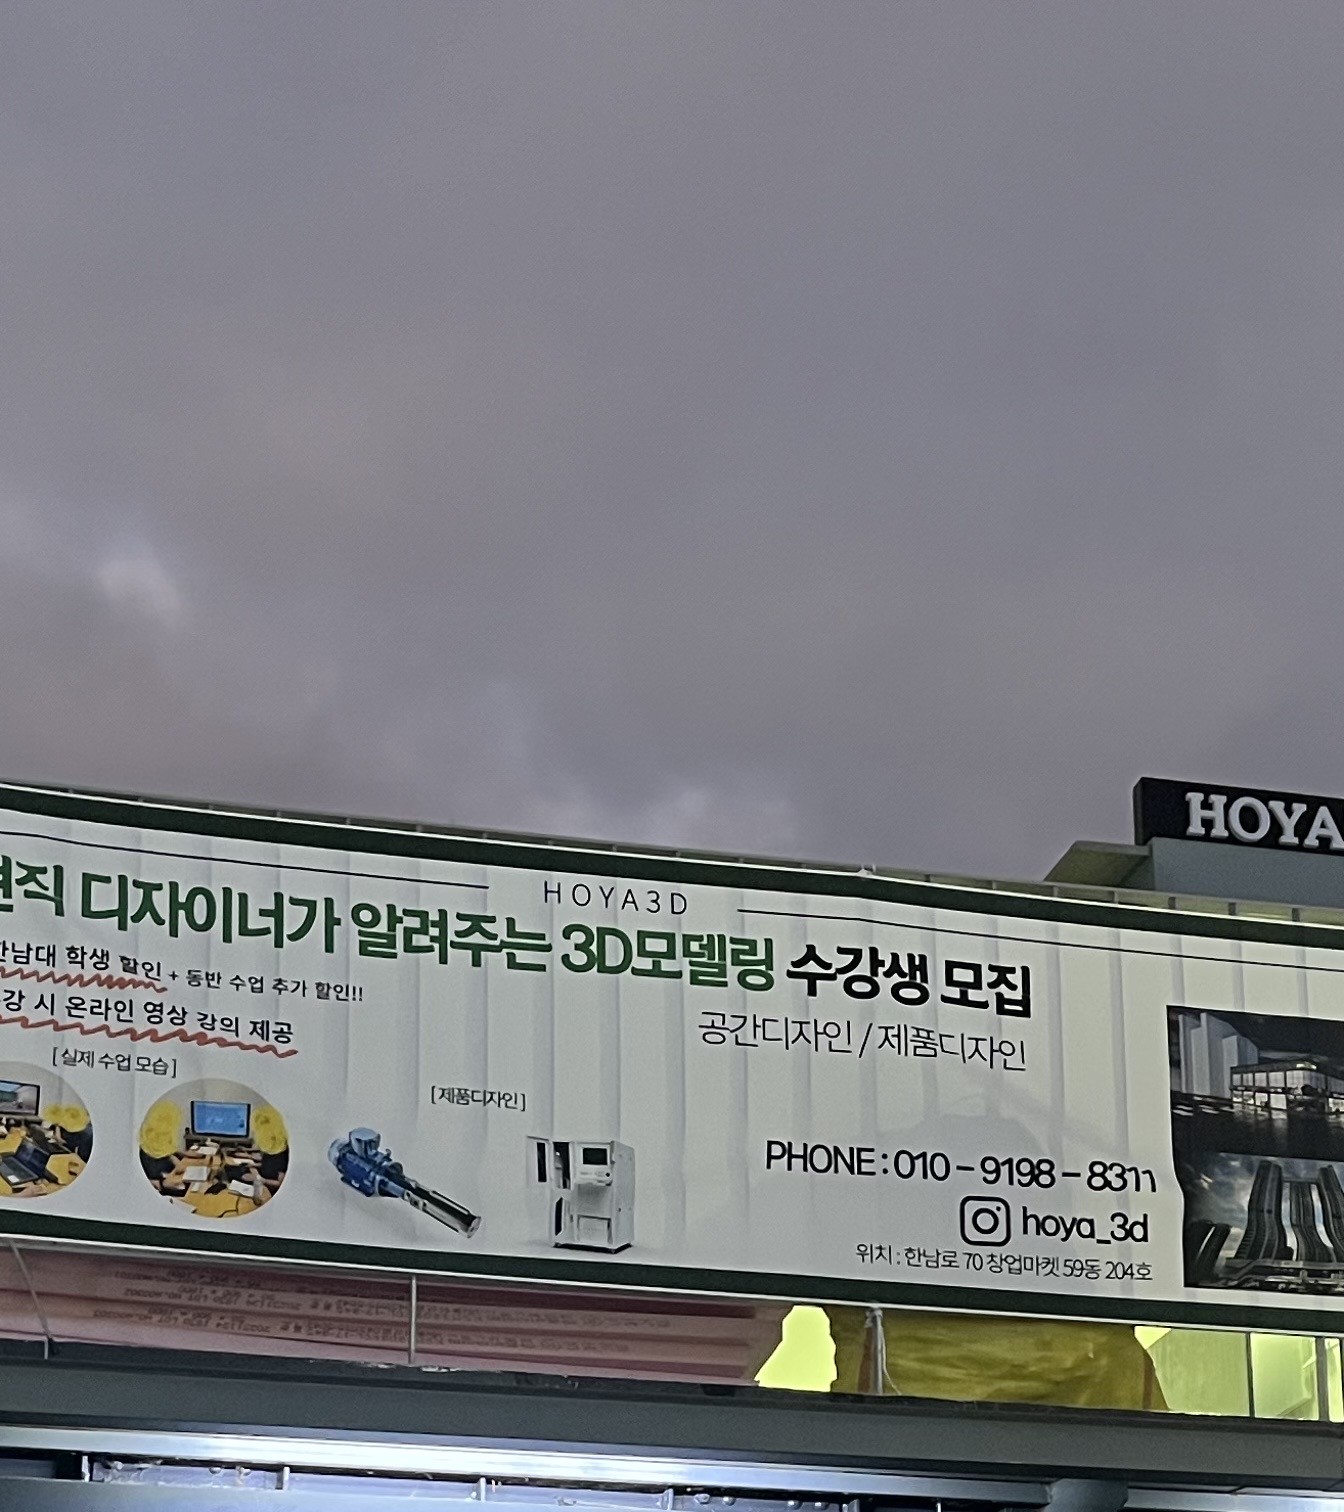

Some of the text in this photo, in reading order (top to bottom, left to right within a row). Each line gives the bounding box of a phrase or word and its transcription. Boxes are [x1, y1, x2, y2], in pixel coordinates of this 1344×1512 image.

[543, 880, 688, 916] HOYA3D
[81, 871, 342, 954] 디자이너가
[351, 903, 553, 973] 알려주는
[561, 923, 775, 992] 3D모델링
[786, 944, 930, 1006] 수강생
[940, 961, 1033, 1019] 모집
[65, 944, 110, 971] 학생
[119, 955, 162, 982] 할인
[186, 969, 222, 989] 동반
[229, 974, 264, 994] 수업
[272, 977, 307, 998] 추가
[315, 981, 363, 1001] 할인!!
[34, 993, 55, 1016] 시
[65, 995, 134, 1023] 온라인
[143, 1001, 188, 1026] 영상
[197, 1011, 239, 1038] 강의
[249, 1019, 294, 1045] 제공
[698, 1011, 852, 1055] 공간디자인
[876, 1022, 1027, 1073] 제품디자인
[98, 1052, 131, 1072] 수업
[1021, 1205, 1149, 1245] hoya_3d
[904, 1246, 960, 1269] 한남로
[963, 1252, 984, 1272] 70
[987, 1253, 1059, 1277] 창업마켓
[1063, 1258, 1102, 1280] 59동
[1105, 1261, 1154, 1281] 204호
